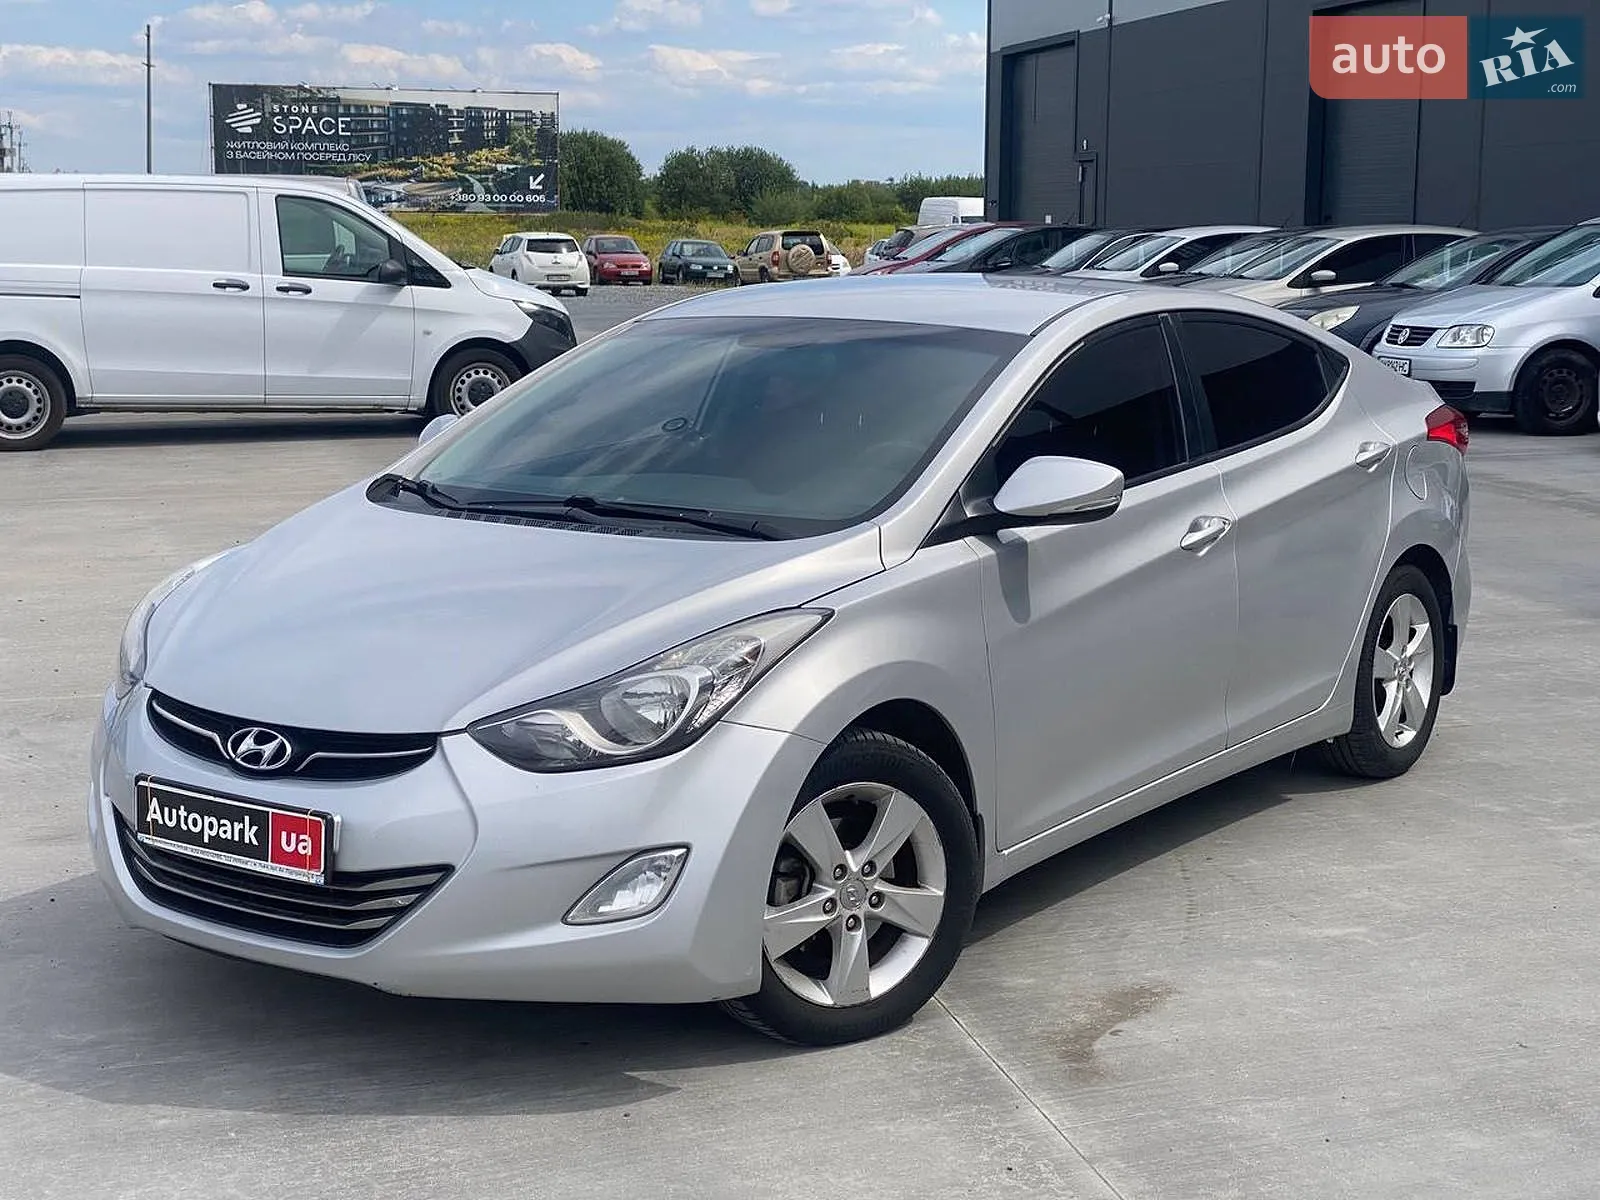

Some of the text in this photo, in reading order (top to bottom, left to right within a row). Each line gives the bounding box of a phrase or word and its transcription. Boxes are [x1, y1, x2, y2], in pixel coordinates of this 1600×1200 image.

[272, 104, 319, 114] STONE
[273, 116, 351, 135] SPACE
[226, 140, 350, 152] ЖИТЛОВИЙ КОМПЛЕКС
[235, 150, 295, 161] БАСЕЙНОМ
[296, 152, 347, 162] ПОСЕРЕД
[348, 153, 372, 162] ЛІСУ
[492, 194, 508, 202] 00
[509, 194, 524, 202] 00
[146, 797, 312, 856] Autopark ua
